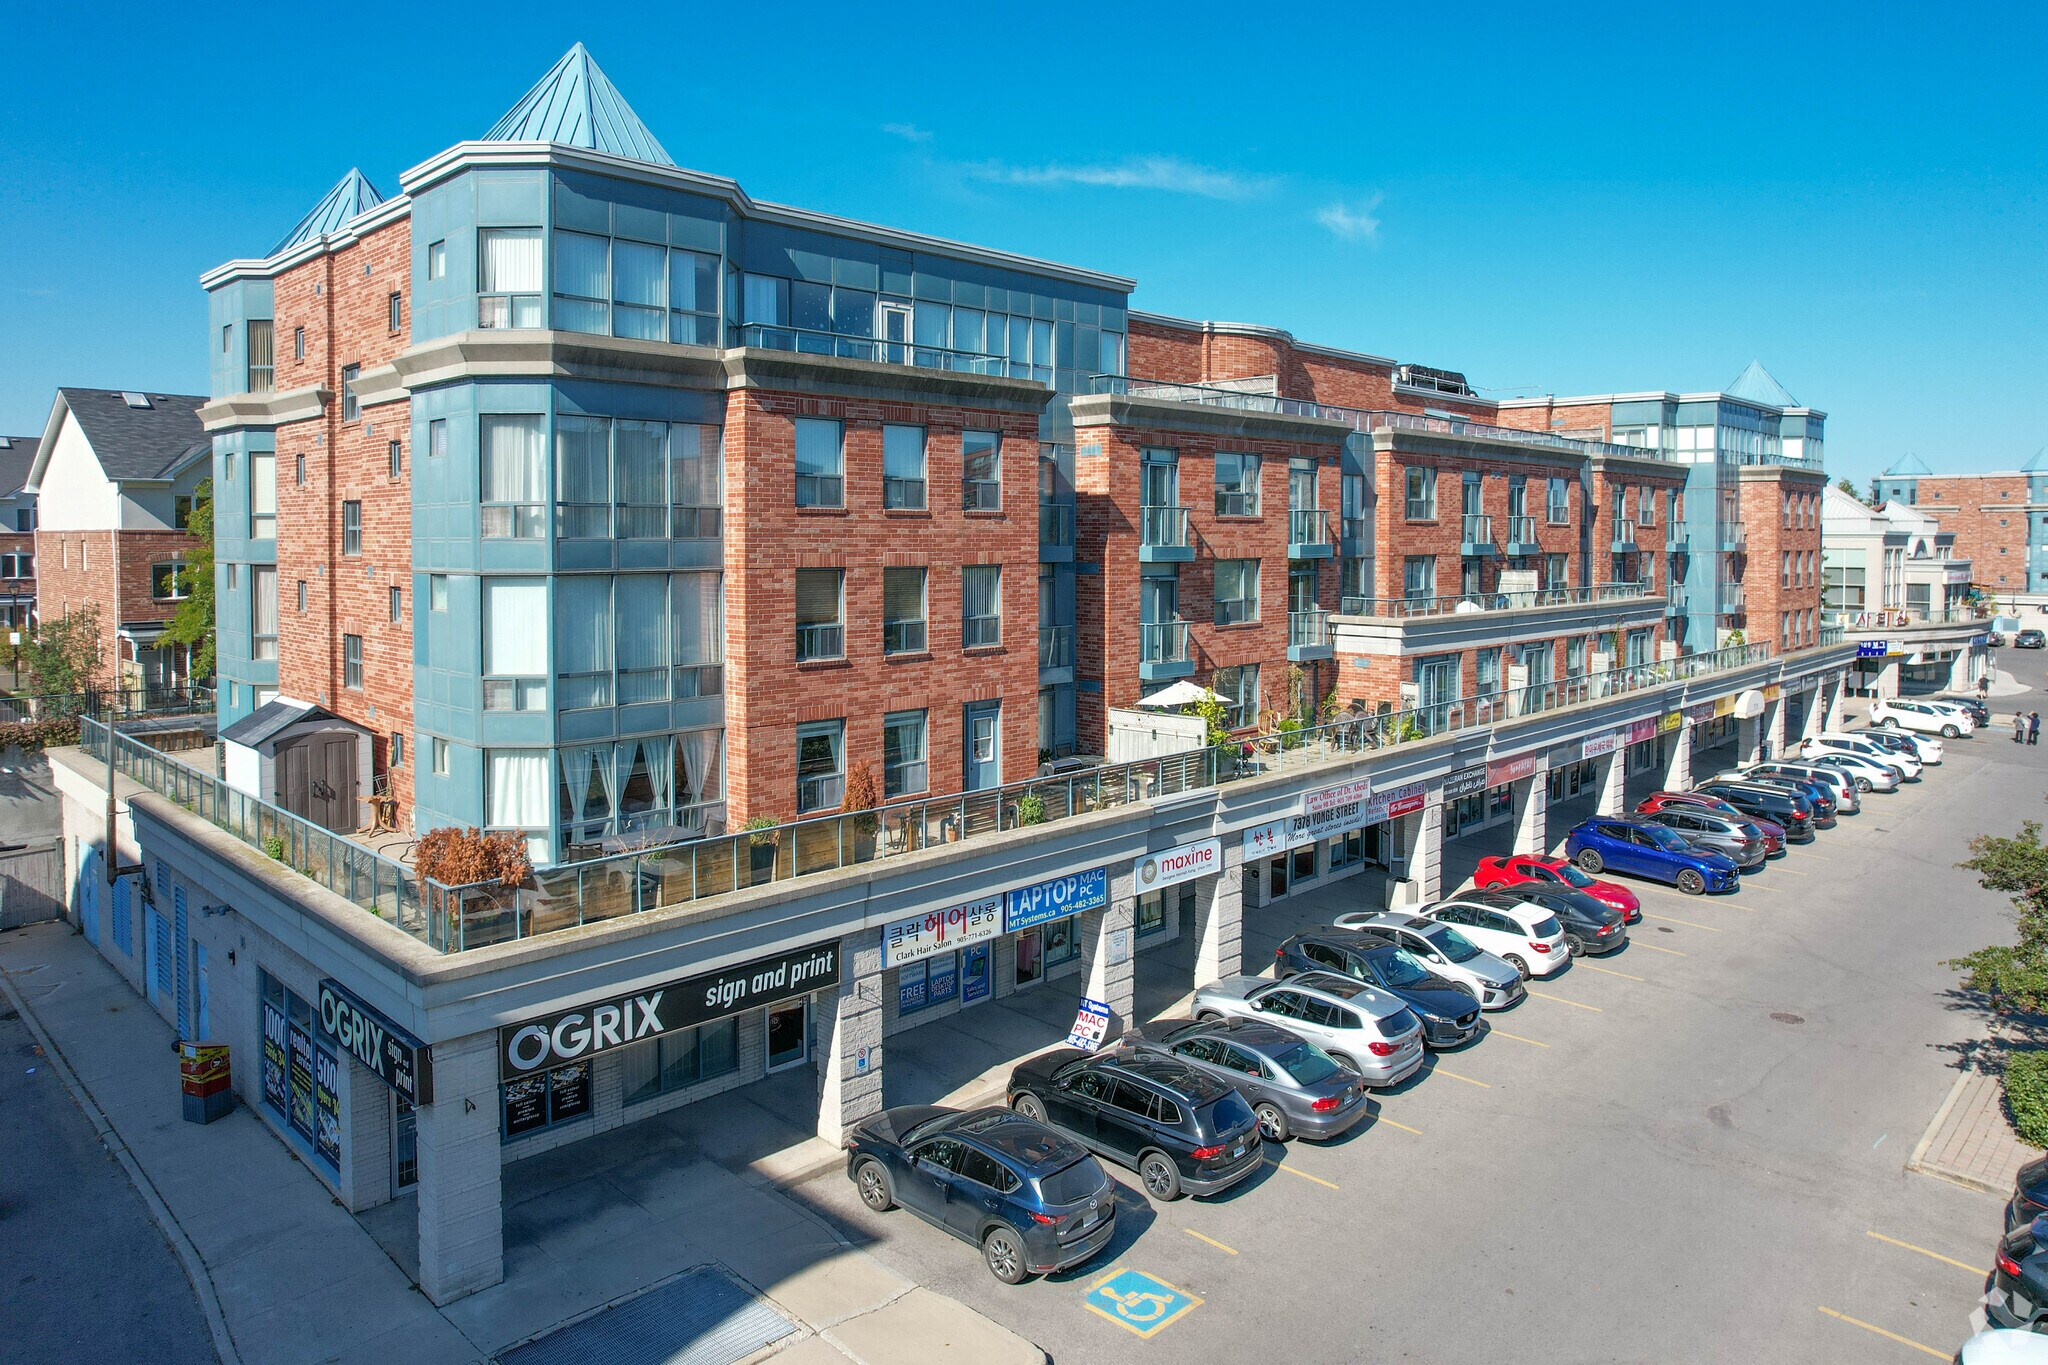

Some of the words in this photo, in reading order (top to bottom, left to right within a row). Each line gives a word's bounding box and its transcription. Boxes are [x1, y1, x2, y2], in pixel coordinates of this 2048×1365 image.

[1463, 768, 1486, 780] EXCHANGE
[1306, 795, 1318, 805] Law
[1319, 790, 1336, 801] Office
[1337, 786, 1344, 796] of
[1368, 792, 1396, 807] Kitchen
[1398, 782, 1425, 799] Cabinet
[1293, 815, 1311, 832] 7378
[1312, 809, 1335, 826] YONGE
[1335, 802, 1360, 819] STREET
[1287, 832, 1306, 842] More
[1306, 826, 1323, 840] great
[1324, 823, 1342, 832] stores
[1161, 846, 1212, 873] maxine
[1080, 870, 1104, 885] MAC
[1009, 877, 1077, 917] LAPTOP
[1080, 884, 1093, 897] PC
[1060, 894, 1104, 913] 905-482-3365
[889, 921, 921, 949] 클락
[924, 906, 967, 942] 헤어
[969, 901, 998, 926] 살롱
[895, 948, 915, 961] Clark
[916, 944, 931, 955] Hair
[933, 939, 952, 951] Salon
[956, 928, 992, 944] 905-771-6326
[970, 945, 981, 956] PC
[931, 973, 955, 987] LAPTOP
[931, 980, 955, 993] DESKTOP
[900, 983, 925, 1001] FREE
[933, 987, 952, 998] PARTS
[508, 990, 664, 1070] OGRIX
[705, 977, 747, 1009] sign
[751, 961, 787, 995] and
[790, 950, 833, 990] print
[1078, 1011, 1105, 1028] MAC
[321, 988, 385, 1077] OGRIX
[1073, 1023, 1090, 1036] PC
[387, 1039, 402, 1064] sign
[317, 1051, 338, 1099] 500
[395, 1068, 413, 1094] print
